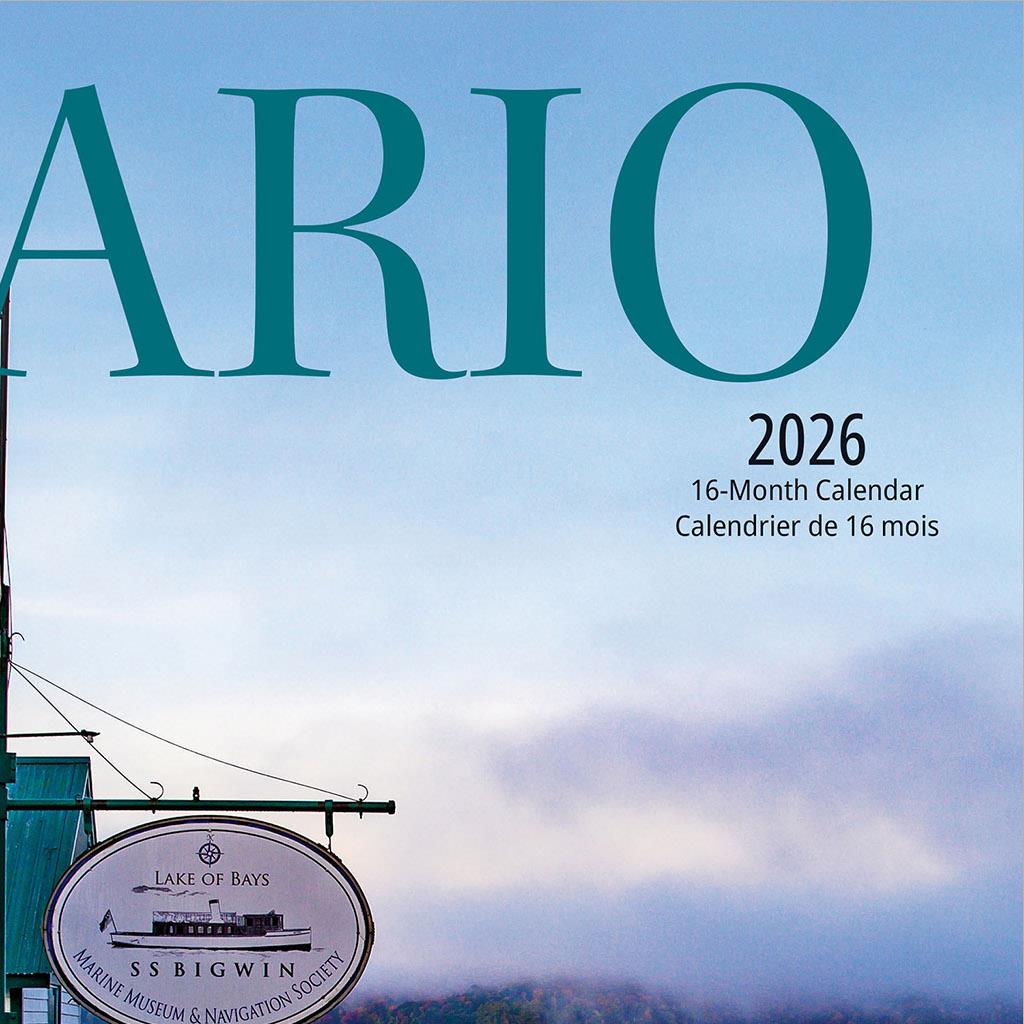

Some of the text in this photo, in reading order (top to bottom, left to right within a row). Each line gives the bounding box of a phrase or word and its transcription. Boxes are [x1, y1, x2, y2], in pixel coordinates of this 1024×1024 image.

[155, 870, 270, 887] LAKE OF BAYS
[174, 961, 295, 978] BIGWIN
[73, 948, 345, 1024] MARINE MUSEUM & NAVIGATION SOCIETY
